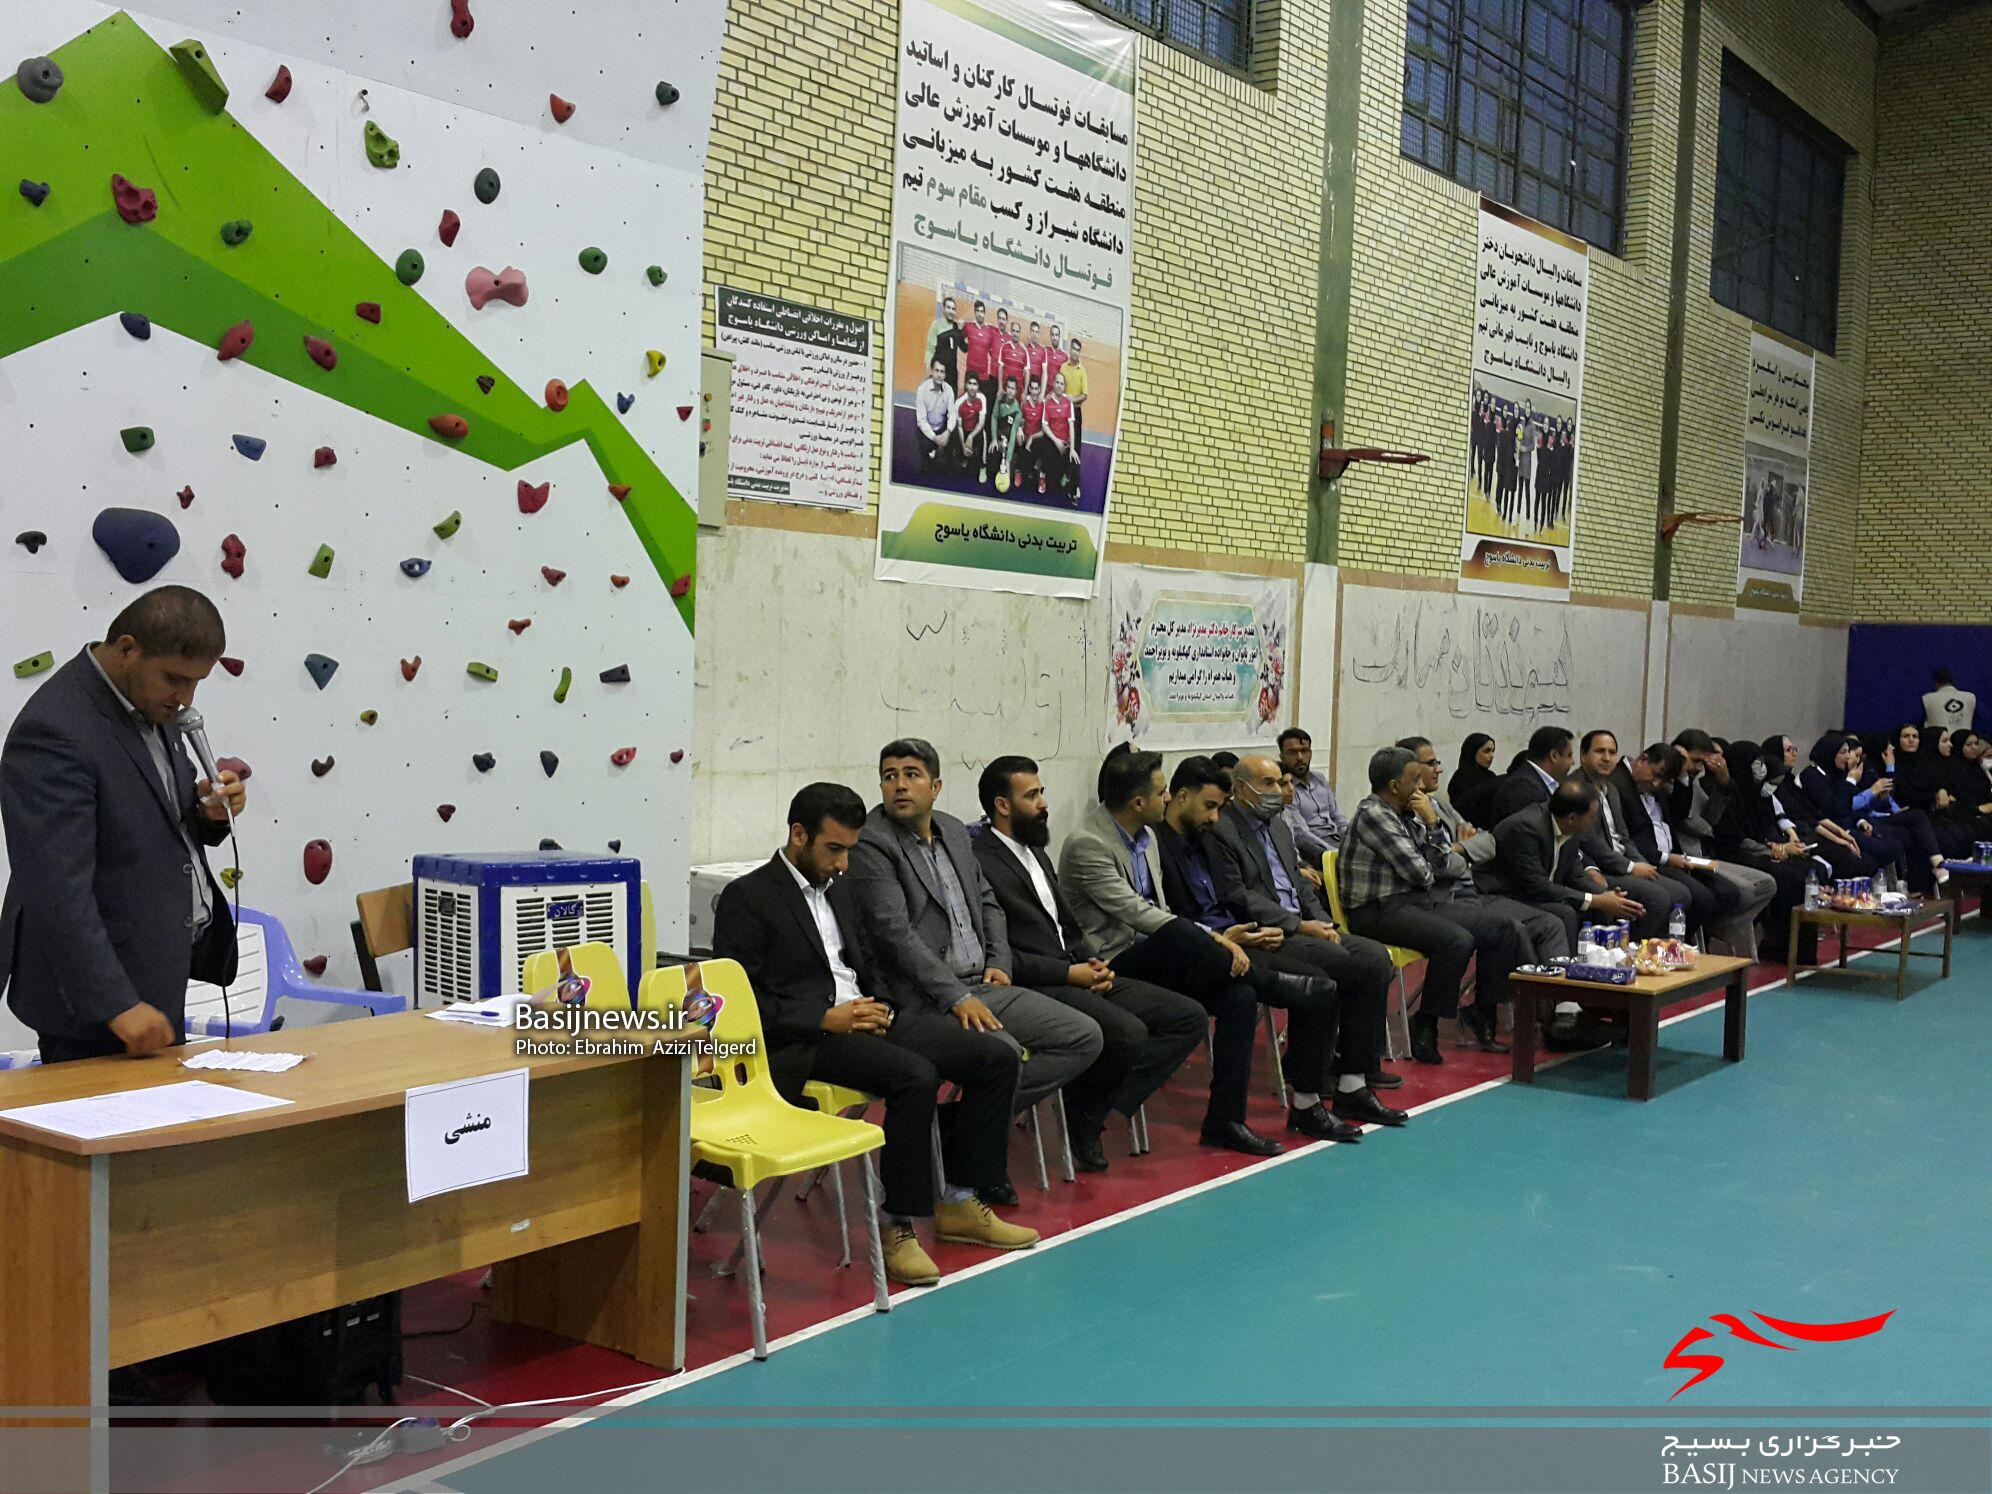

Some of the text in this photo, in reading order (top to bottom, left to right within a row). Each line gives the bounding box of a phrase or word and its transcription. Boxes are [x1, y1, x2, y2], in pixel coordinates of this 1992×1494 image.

[905, 82, 940, 107] عالی
[906, 40, 1128, 145] مسابقات فوتسال کارکنان و اساتید
[944, 100, 995, 131] آموزش
[998, 119, 1049, 156] موسسات
[1053, 146, 1060, 162] و
[903, 128, 1126, 219] منطقه هفت کشور به میزبانی
[903, 166, 1124, 254] دانشگاه شیراز و کسب مقام سوم تیم
[914, 213, 1112, 290] فوتسال دانشگاه یاسوج
[935, 523, 1077, 553] تربیت بدنی دانشگاه یاسوج
[445, 1112, 491, 1145] منشی
